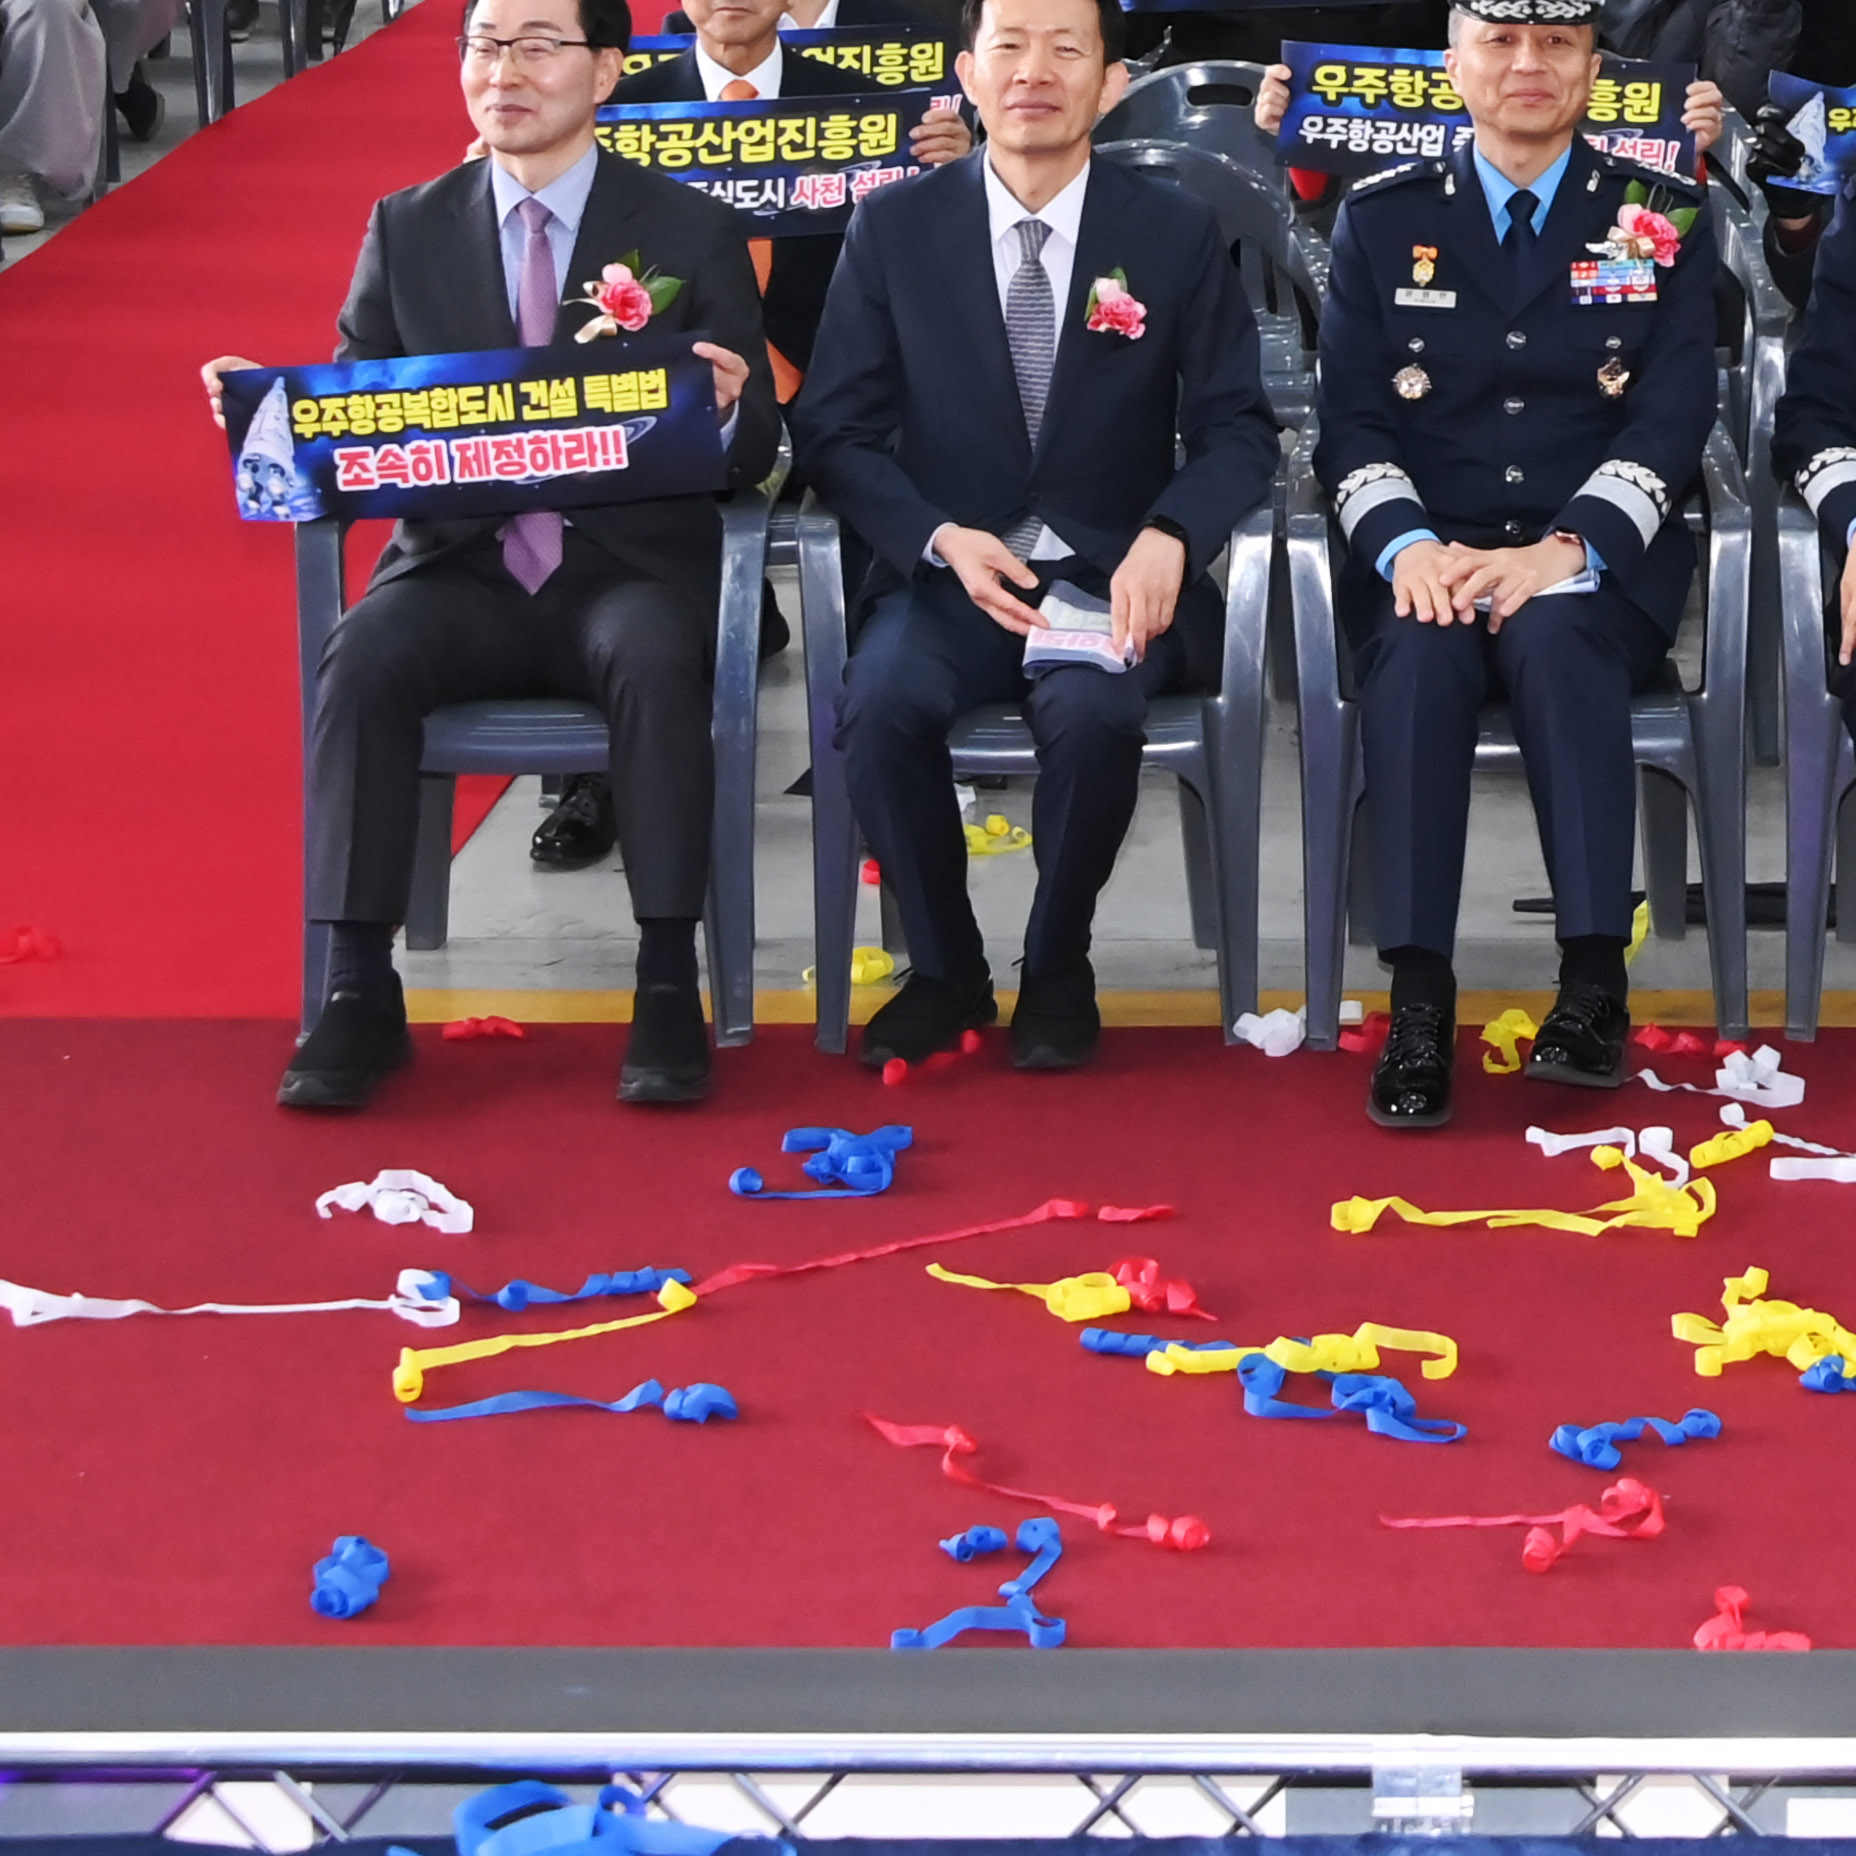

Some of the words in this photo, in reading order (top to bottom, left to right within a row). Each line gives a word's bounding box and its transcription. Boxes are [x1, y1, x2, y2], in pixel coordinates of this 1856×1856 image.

[1300, 116, 1445, 158] 우주항공산업
[792, 175, 845, 209] 사천
[292, 384, 515, 438] 우주항공복합도시
[520, 380, 578, 419] 건설
[583, 368, 668, 412] 특별법
[336, 437, 450, 491] 조속히
[453, 425, 628, 484] 제정하라!!
